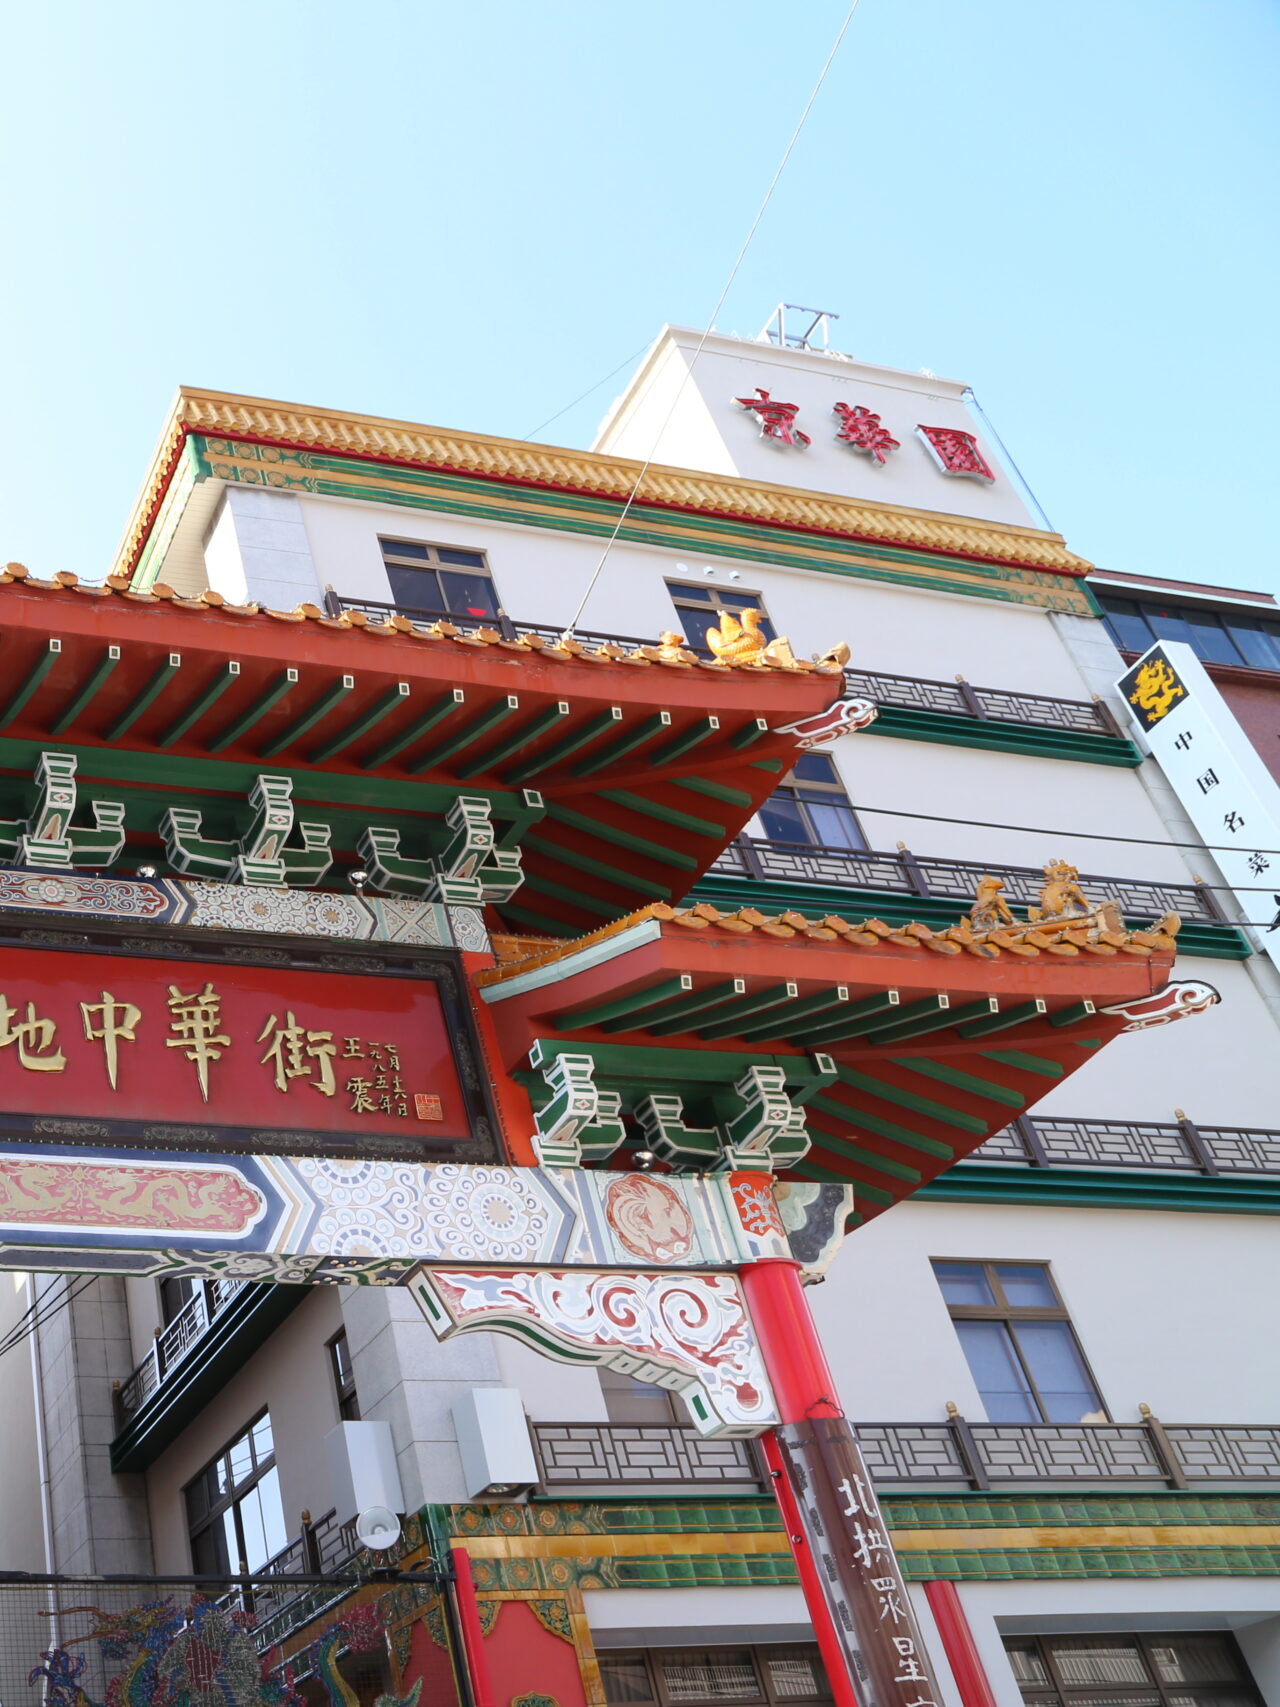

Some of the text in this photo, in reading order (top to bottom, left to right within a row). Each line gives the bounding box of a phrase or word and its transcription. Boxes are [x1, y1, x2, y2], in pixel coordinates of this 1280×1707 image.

[1174, 730, 1270, 879] 中国名菜
[343, 1037, 379, 1114] 王震
[368, 1042, 392, 1116] 一九八五年
